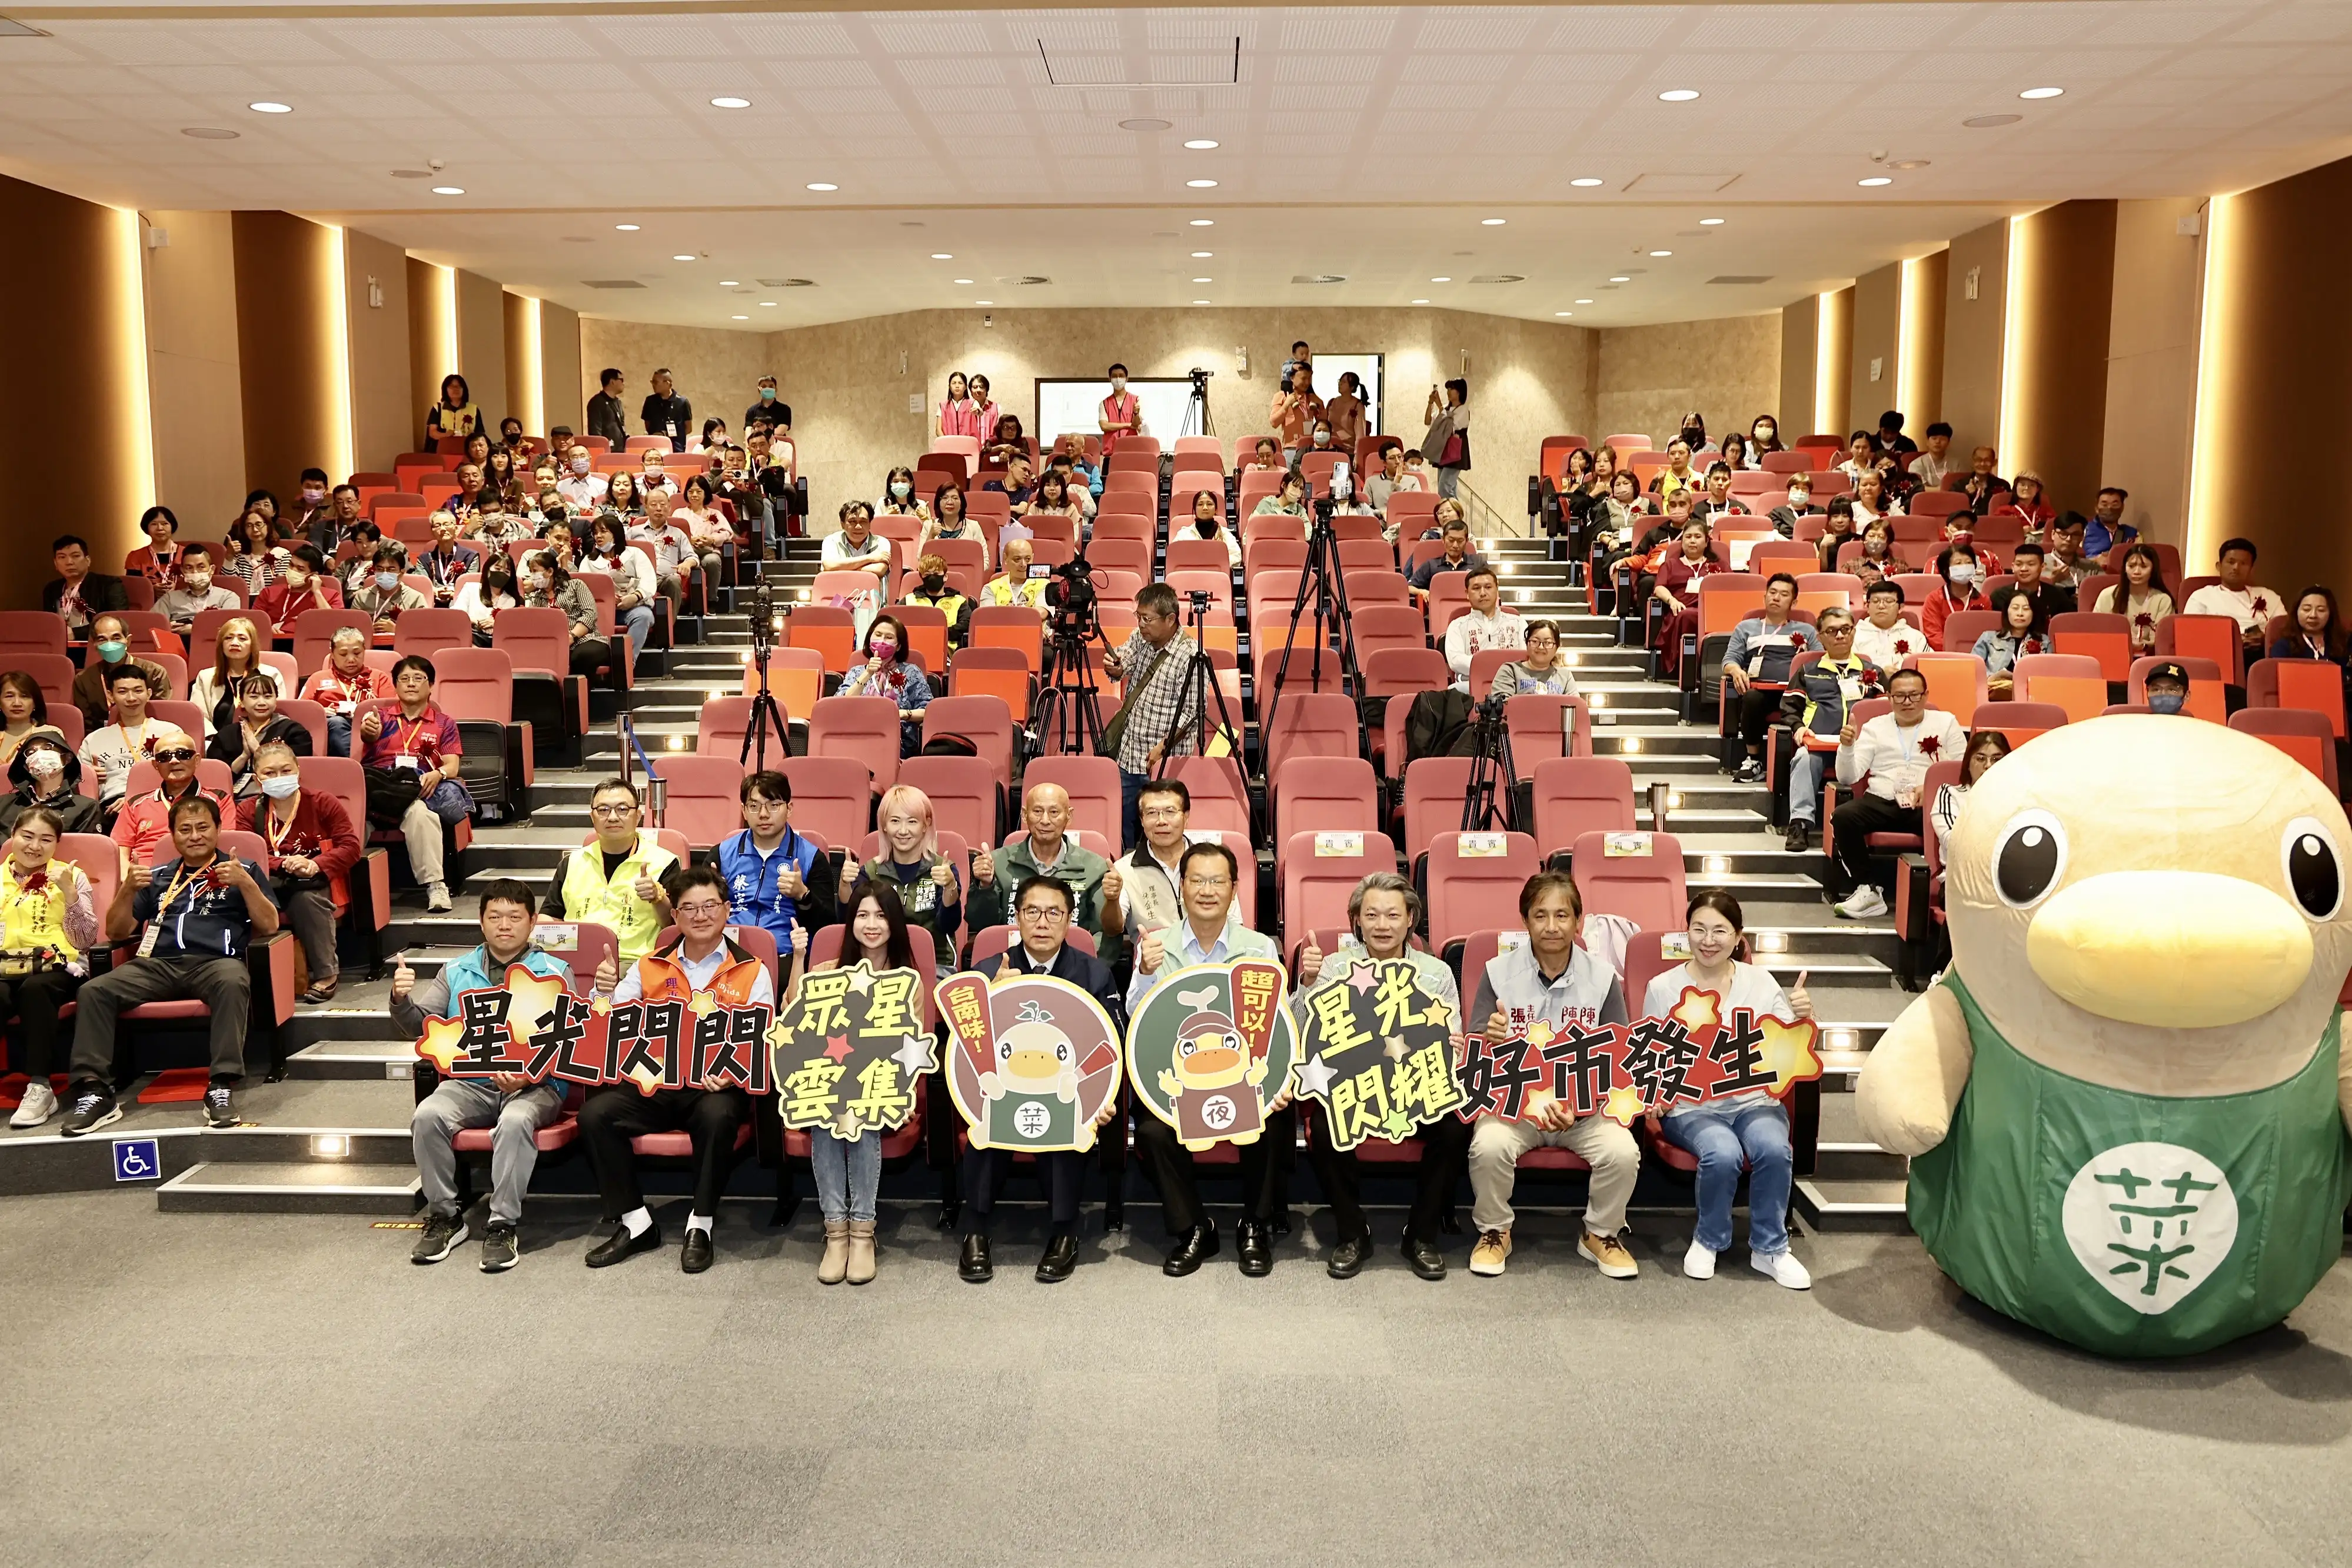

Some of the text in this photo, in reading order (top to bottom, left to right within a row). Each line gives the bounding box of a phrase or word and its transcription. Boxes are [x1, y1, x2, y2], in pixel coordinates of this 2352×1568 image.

[1149, 885, 1159, 907] 理事長
[535, 934, 567, 944] 貴賓
[451, 989, 770, 1090] 星光閃閃
[947, 986, 986, 1053] 台南味!
[1240, 970, 1276, 1048] 超可以!
[1313, 966, 1427, 1060] 星光
[784, 1057, 908, 1122] 雲集
[1330, 1040, 1459, 1143] 閃耀
[1456, 1011, 1779, 1120] 好市發生
[1020, 1107, 1046, 1134] 菜
[1206, 1100, 1232, 1124] 夜
[2094, 1167, 2218, 1296] 菜
